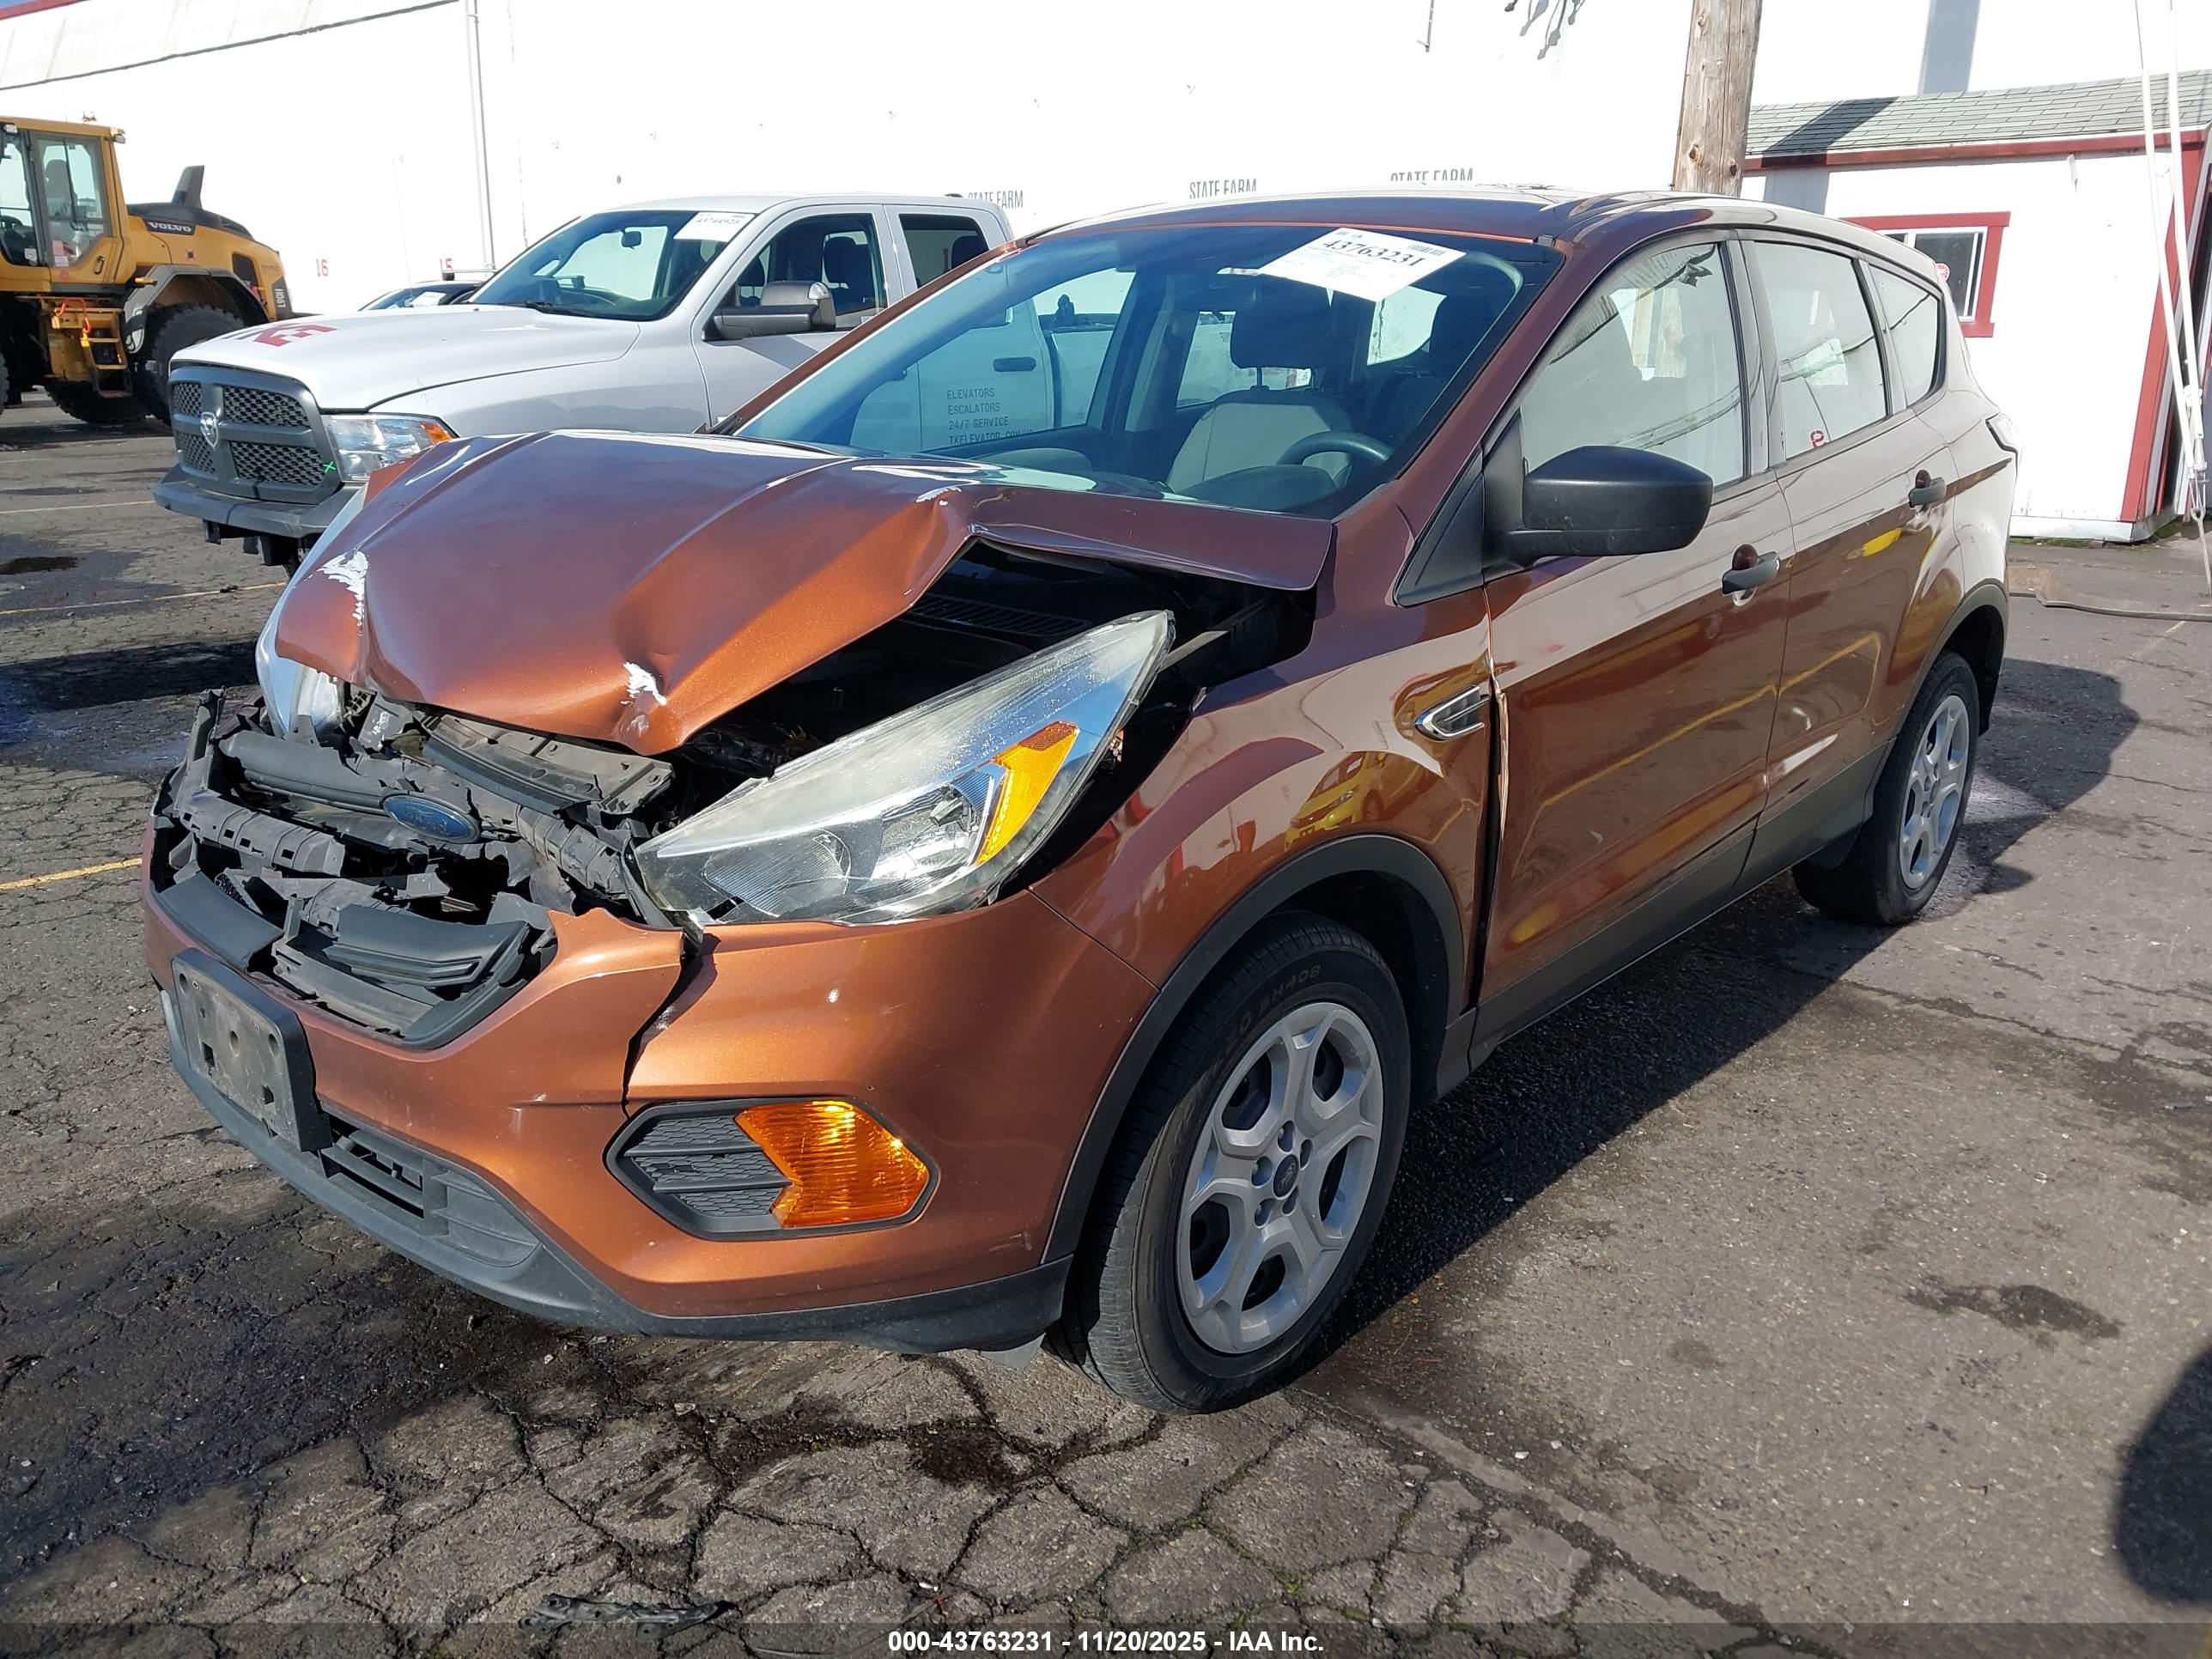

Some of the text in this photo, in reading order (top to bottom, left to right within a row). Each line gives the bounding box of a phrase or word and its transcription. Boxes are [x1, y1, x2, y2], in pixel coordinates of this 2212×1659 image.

[1189, 179, 1220, 199] STATE
[147, 222, 192, 233] VOLVO
[1322, 240, 1426, 267] 43763231
[316, 258, 329, 276] 16
[947, 387, 995, 399] ELEVATORS
[948, 402, 1001, 416] ESCALATORS
[949, 416, 1010, 430] 24/7 SERVICE
